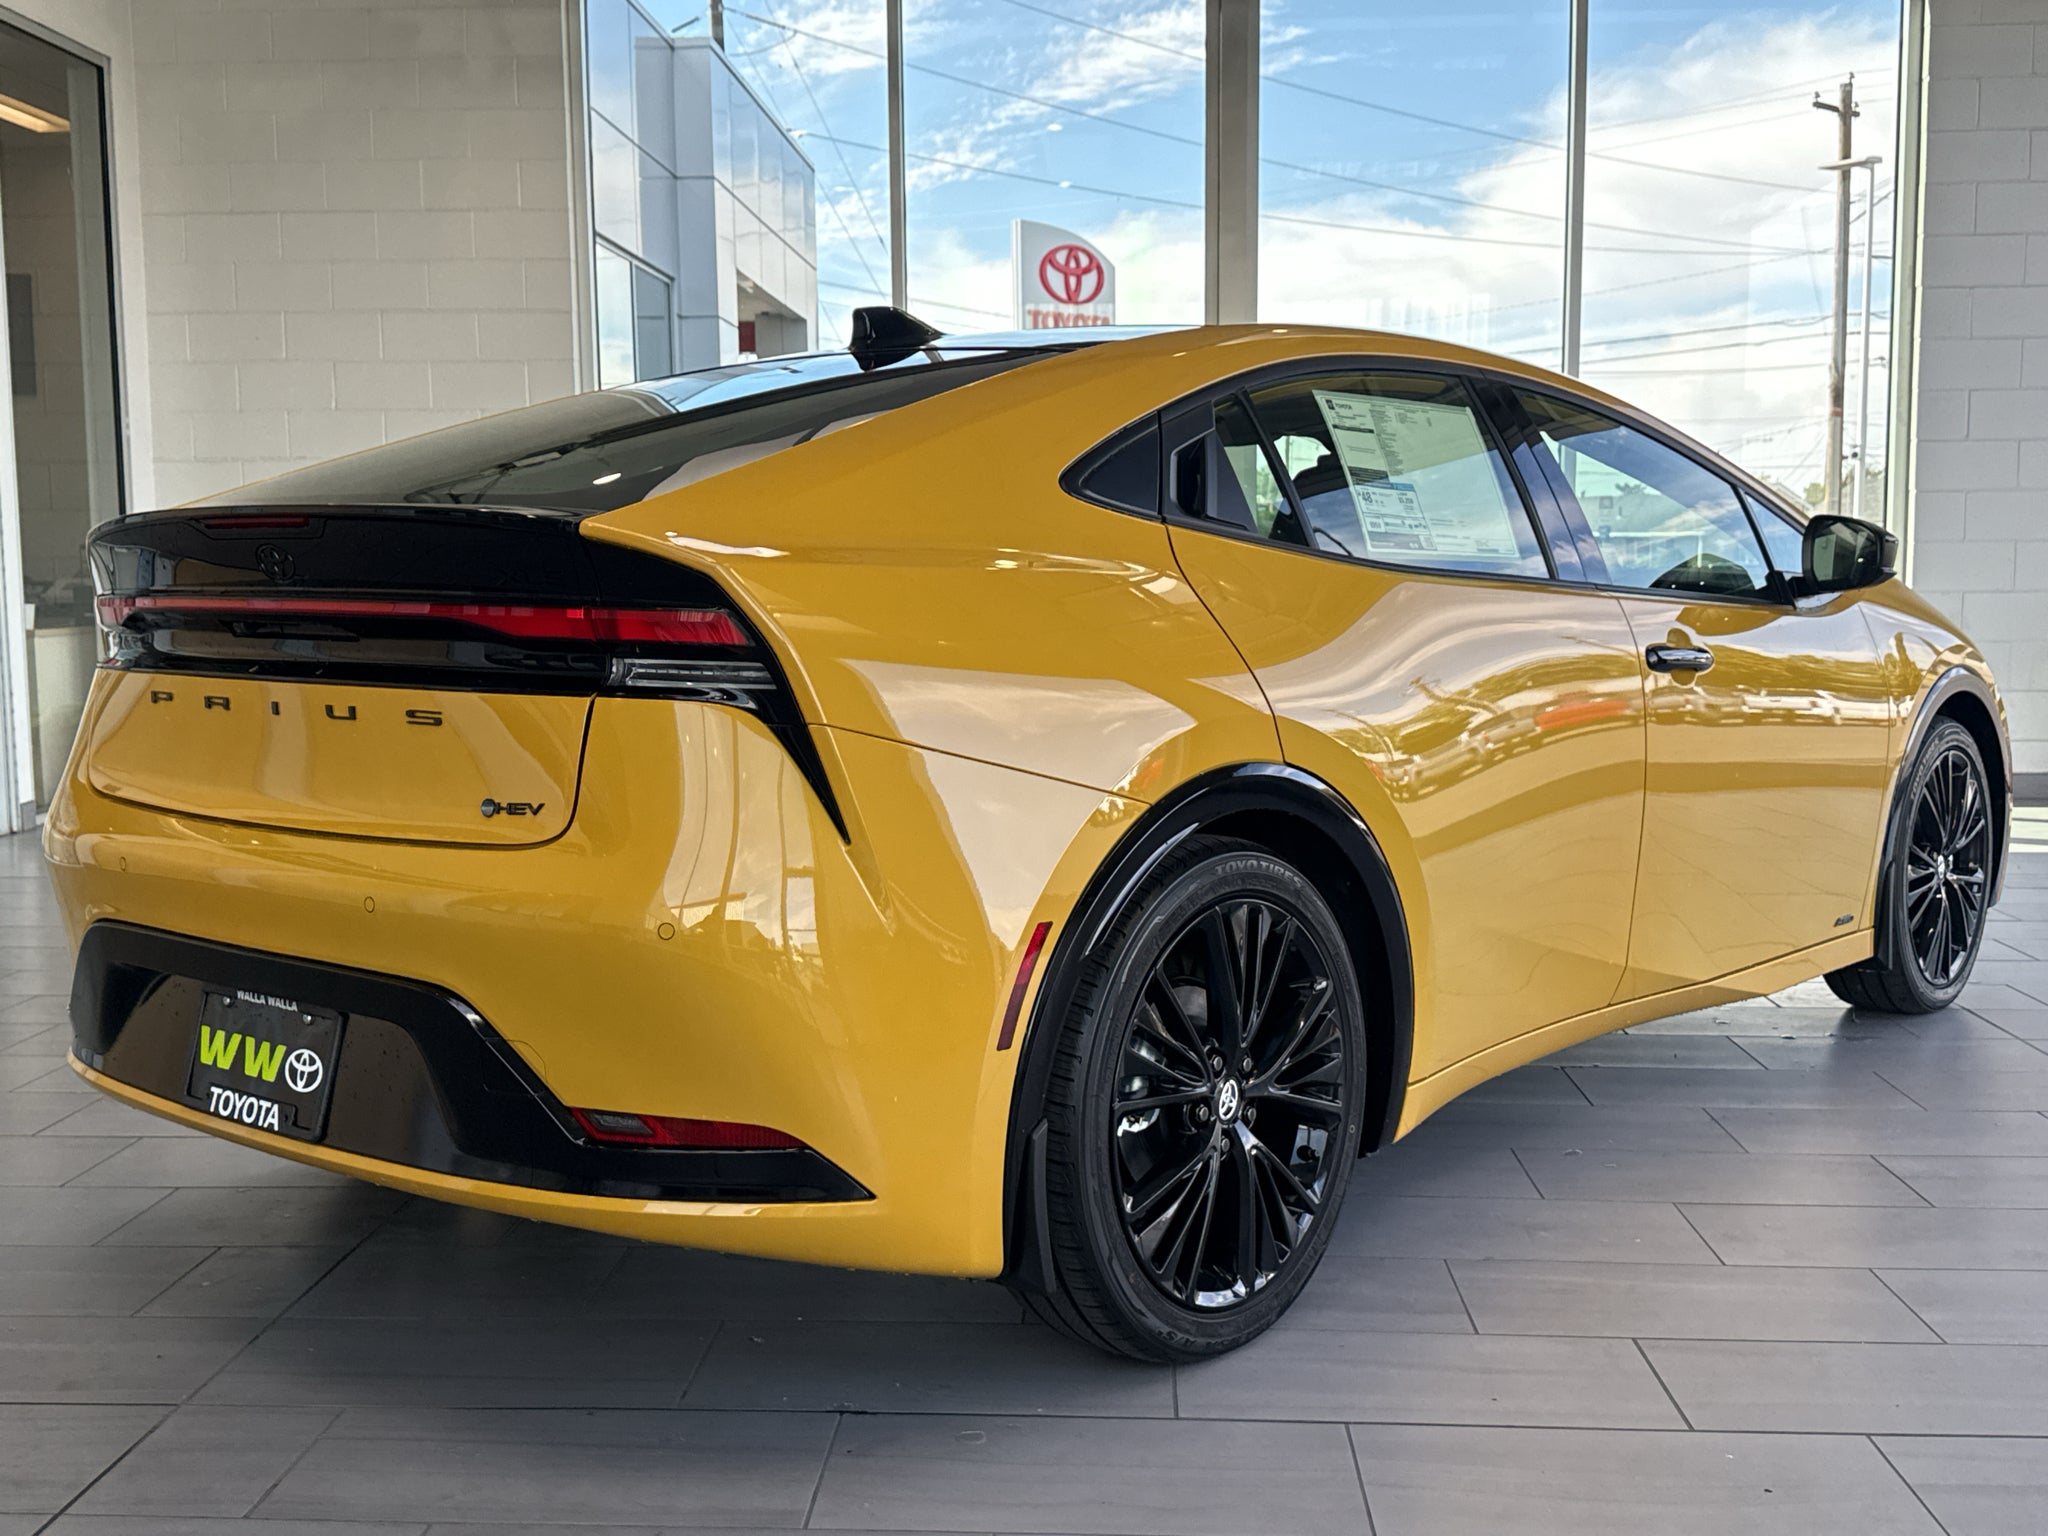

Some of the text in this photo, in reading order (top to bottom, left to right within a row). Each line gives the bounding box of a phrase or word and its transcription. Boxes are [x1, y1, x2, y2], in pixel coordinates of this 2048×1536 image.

[150, 690, 443, 727] PRIUS
[494, 801, 546, 817] HEV
[1215, 859, 1303, 888] TOYO TIRES
[237, 990, 298, 1011] WALLA WALLA
[200, 1024, 287, 1083] WW
[210, 1086, 280, 1132] TOYOTA
